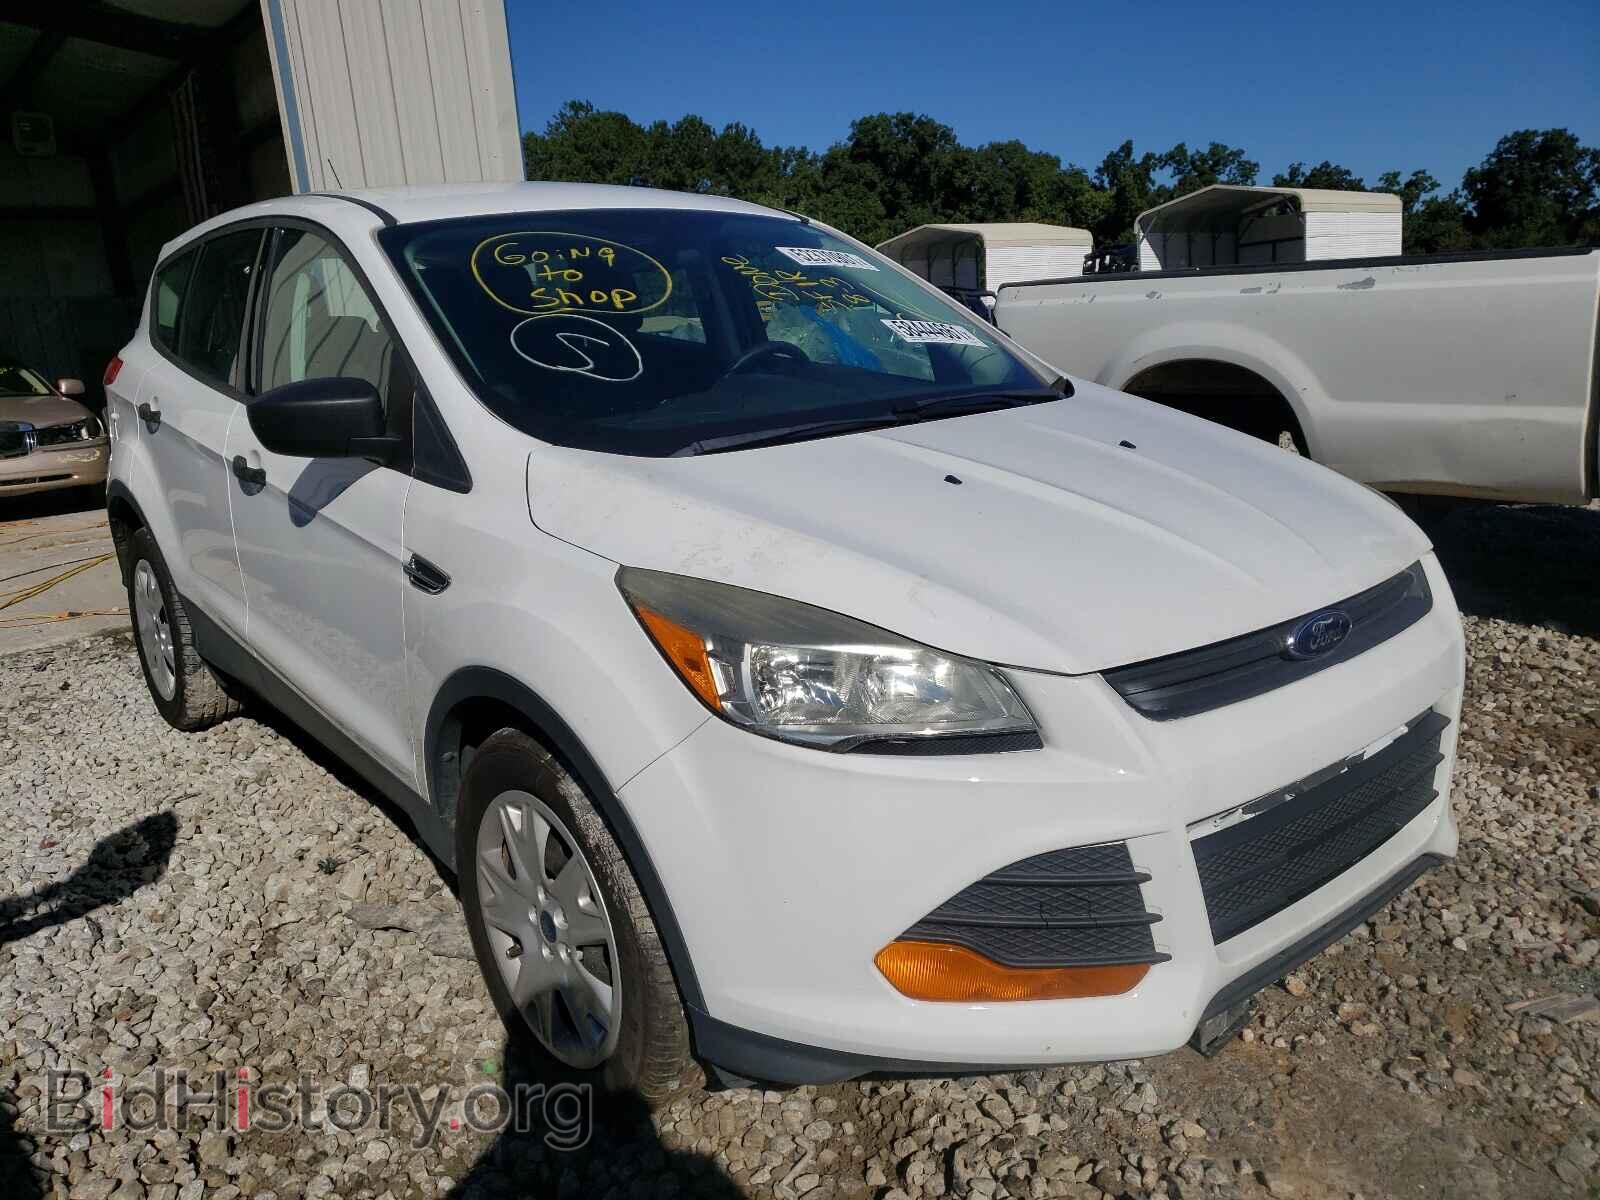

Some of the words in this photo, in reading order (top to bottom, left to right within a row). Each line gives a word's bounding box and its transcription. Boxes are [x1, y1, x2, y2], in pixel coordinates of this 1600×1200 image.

[536, 264, 583, 282] to
[890, 320, 968, 341] 58444661
[1310, 616, 1343, 650] Ford
